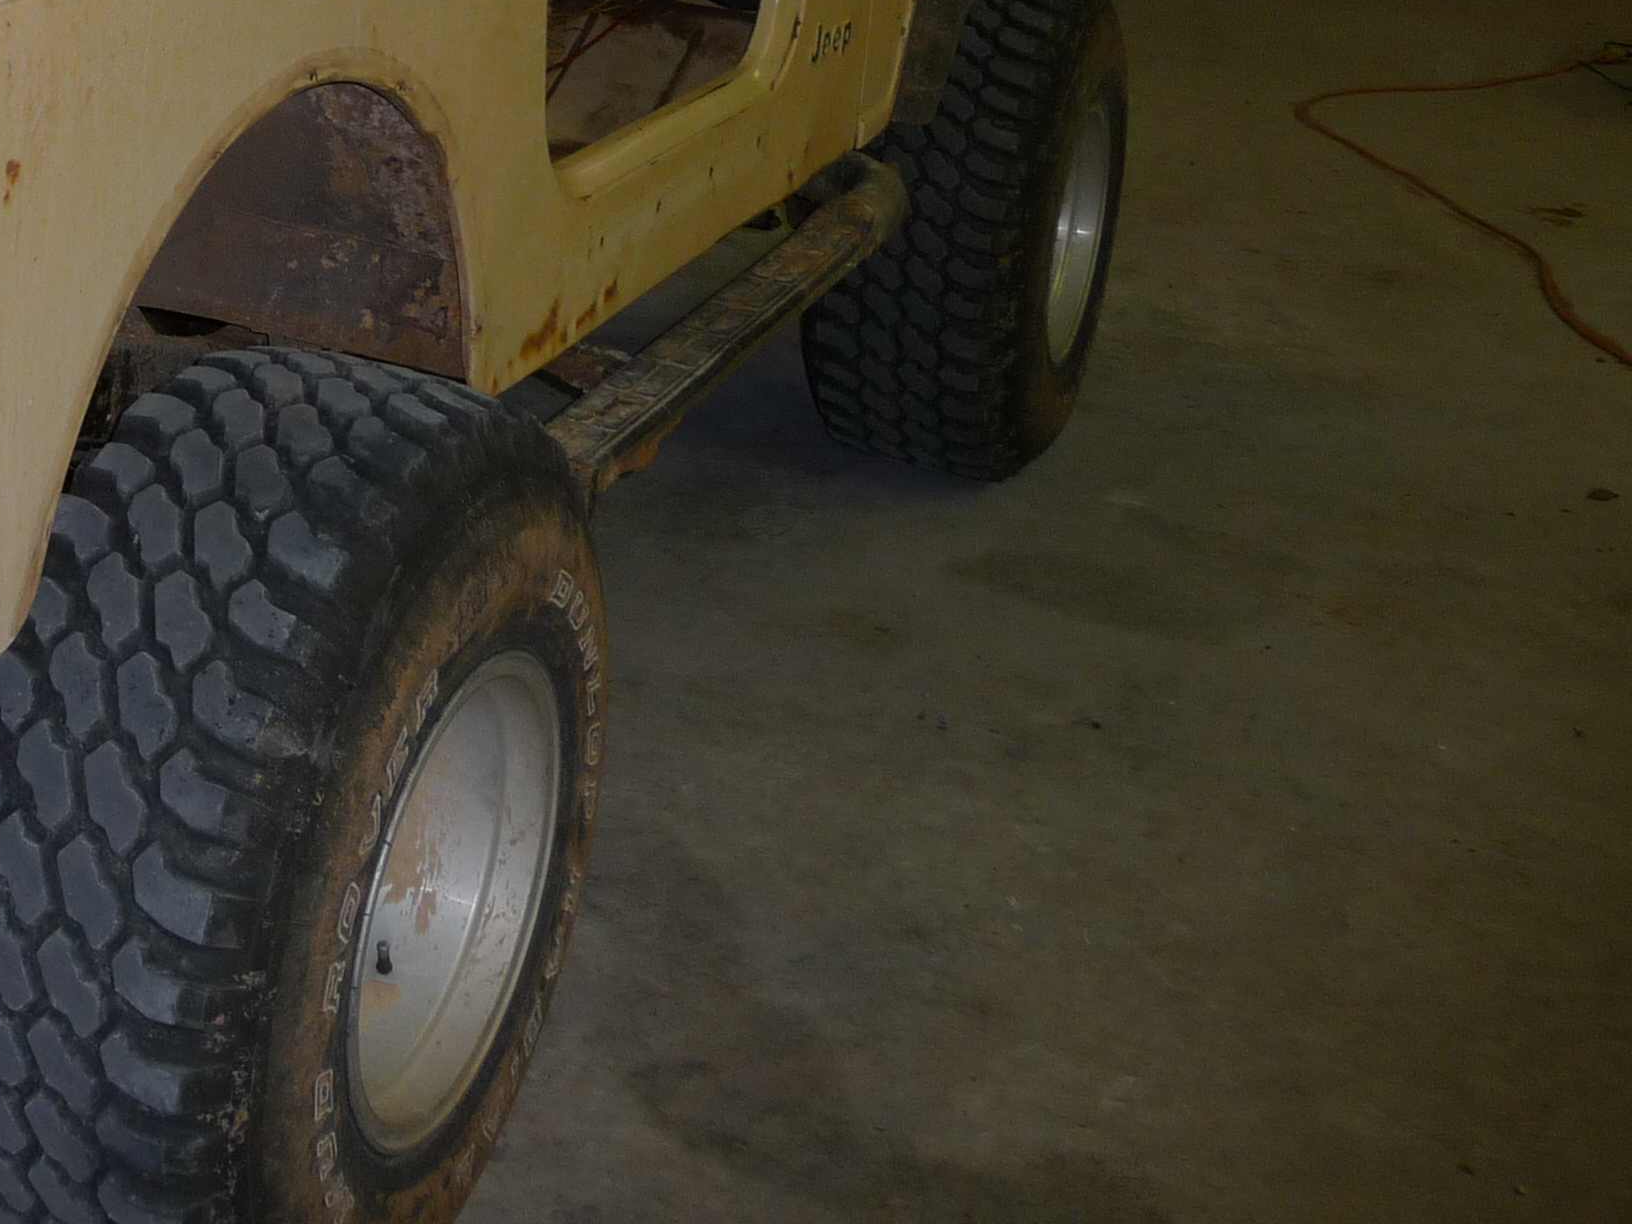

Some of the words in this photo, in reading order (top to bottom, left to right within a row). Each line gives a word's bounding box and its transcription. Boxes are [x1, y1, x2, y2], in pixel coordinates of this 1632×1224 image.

[811, 21, 852, 63] Jeep
[549, 568, 602, 821] DUNLOP
[321, 667, 440, 1014] ROVER
